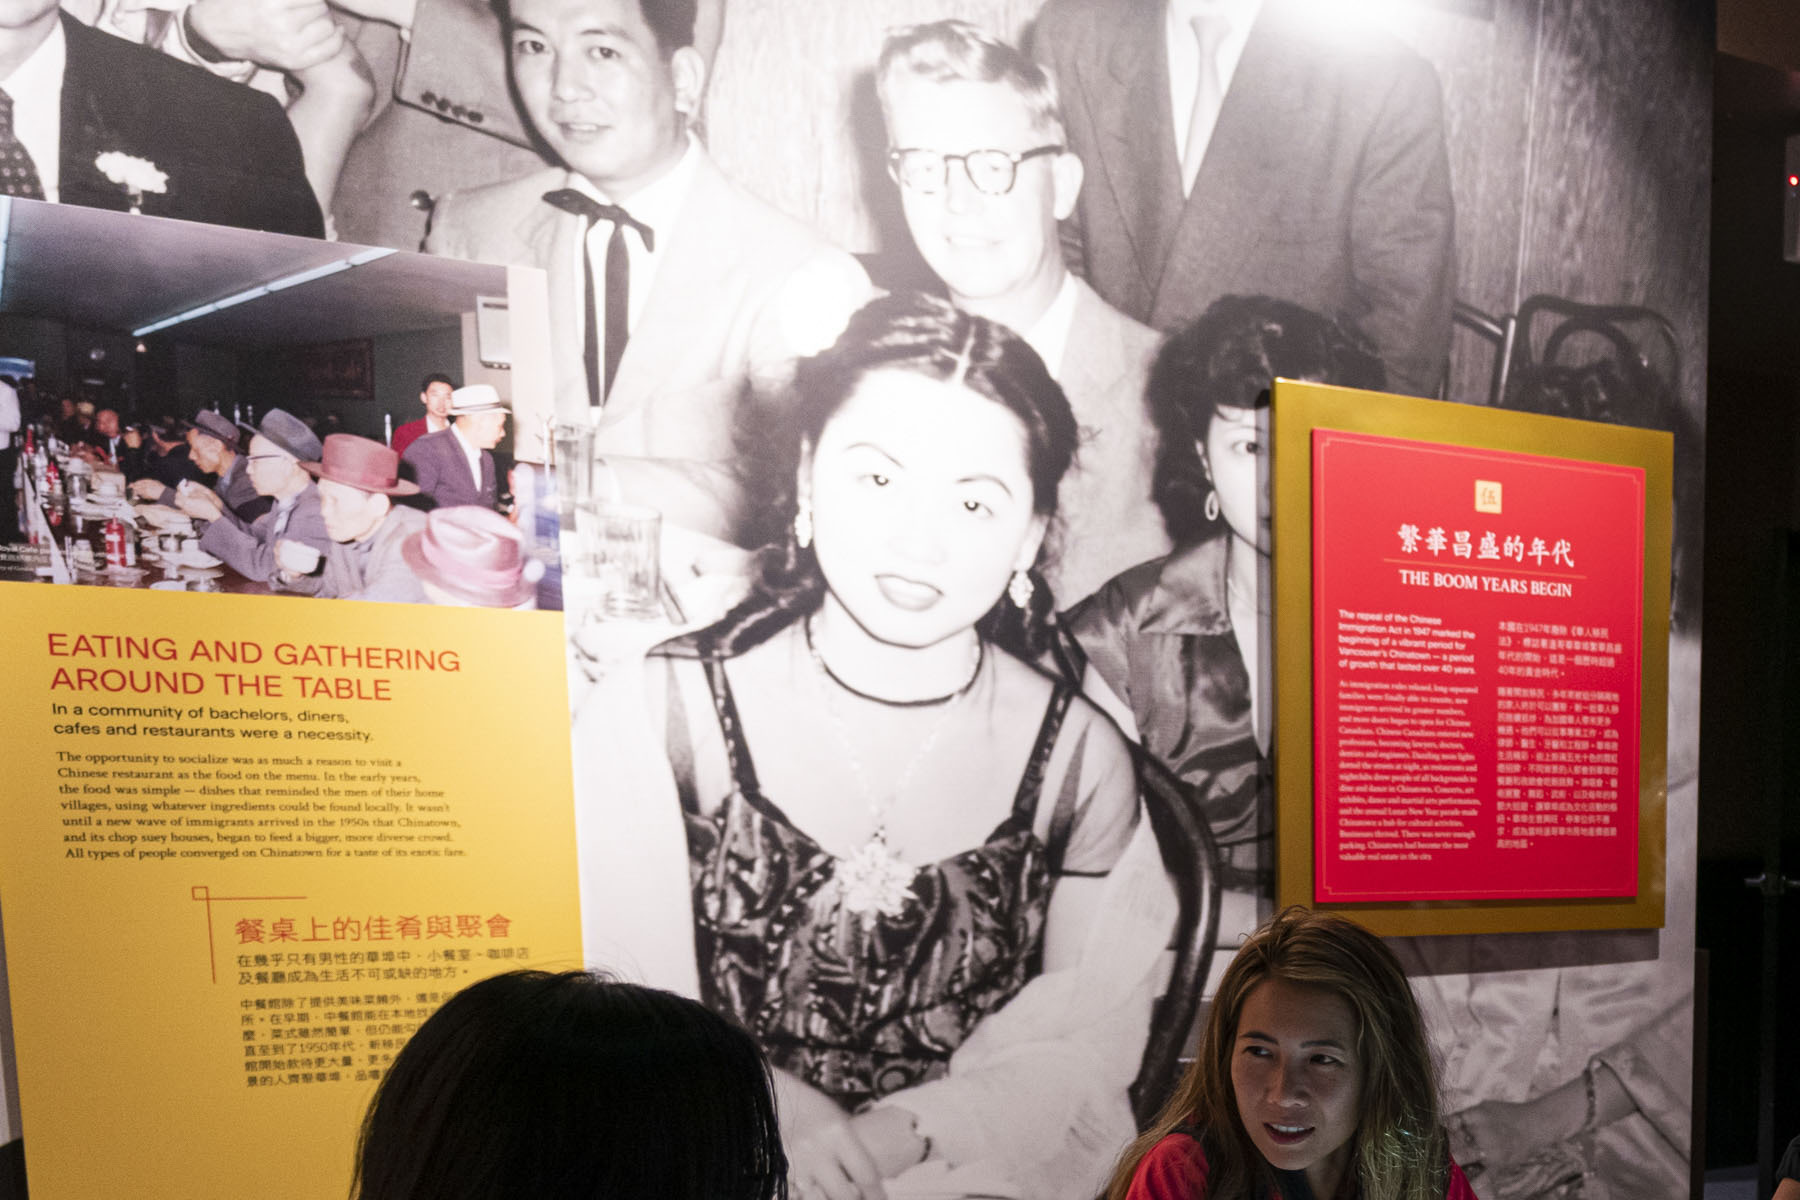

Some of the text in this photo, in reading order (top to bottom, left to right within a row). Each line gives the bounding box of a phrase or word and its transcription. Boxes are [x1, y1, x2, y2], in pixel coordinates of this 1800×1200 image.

[1398, 524, 1574, 567] 繁華昌盛的年代
[1399, 569, 1572, 597] THE BOOM YEARS BEGIN
[47, 633, 461, 672] EATING AND GATHERING
[51, 667, 392, 701] AROUND THE TABLE
[52, 703, 350, 724] In a community of bachelors, diners,
[53, 722, 374, 743] cafes and restaurants were a necessity.
[56, 751, 82, 762] The
[85, 753, 160, 766] opportunity
[162, 755, 176, 763] to
[178, 753, 229, 764] socialize
[232, 757, 255, 765] was
[272, 756, 304, 766] much
[370, 759, 393, 767] visit
[57, 767, 109, 778] Chinese
[112, 770, 174, 779] restaurant
[177, 772, 190, 780] as
[192, 769, 212, 780] the
[215, 770, 243, 780] food
[264, 771, 283, 781] the
[324, 771, 336, 781] In
[339, 772, 358, 781] the
[360, 772, 387, 784] early
[59, 784, 80, 794] the
[83, 784, 112, 795] food
[114, 787, 139, 795] was
[141, 784, 182, 797] simple
[198, 785, 236, 796] dishes
[238, 786, 262, 796] that
[265, 786, 320, 796] reminded
[322, 786, 342, 796] the
[344, 789, 369, 797] men
[371, 787, 384, 797] of
[385, 787, 413, 797] their
[114, 801, 149, 813] using
[151, 800, 208, 811] whatever
[210, 801, 277, 814] ingredients
[278, 802, 310, 812] could
[312, 802, 327, 811] be
[329, 802, 363, 812] found
[62, 816, 93, 826] until
[106, 818, 132, 826] new
[170, 816, 184, 826] of
[186, 817, 255, 829] immigrants
[257, 817, 300, 827] arrived
[302, 819, 315, 827] in
[317, 817, 336, 827] the
[372, 817, 394, 827] that
[64, 832, 88, 842] and
[90, 832, 106, 842] its
[108, 831, 138, 845] chop
[141, 835, 168, 844] suey
[216, 832, 252, 844] began
[254, 834, 267, 842] to
[269, 833, 294, 842] feed
[376, 832, 415, 842] diverse
[65, 848, 85, 858] All
[87, 850, 121, 861] types
[122, 848, 137, 858] of
[138, 847, 178, 861] people
[180, 847, 240, 860] converged
[260, 847, 324, 857] Chinatown
[326, 847, 343, 857] for
[381, 848, 393, 857] of
[395, 849, 408, 857] its
[235, 913, 512, 944] 餐桌上的佳肴與聚會
